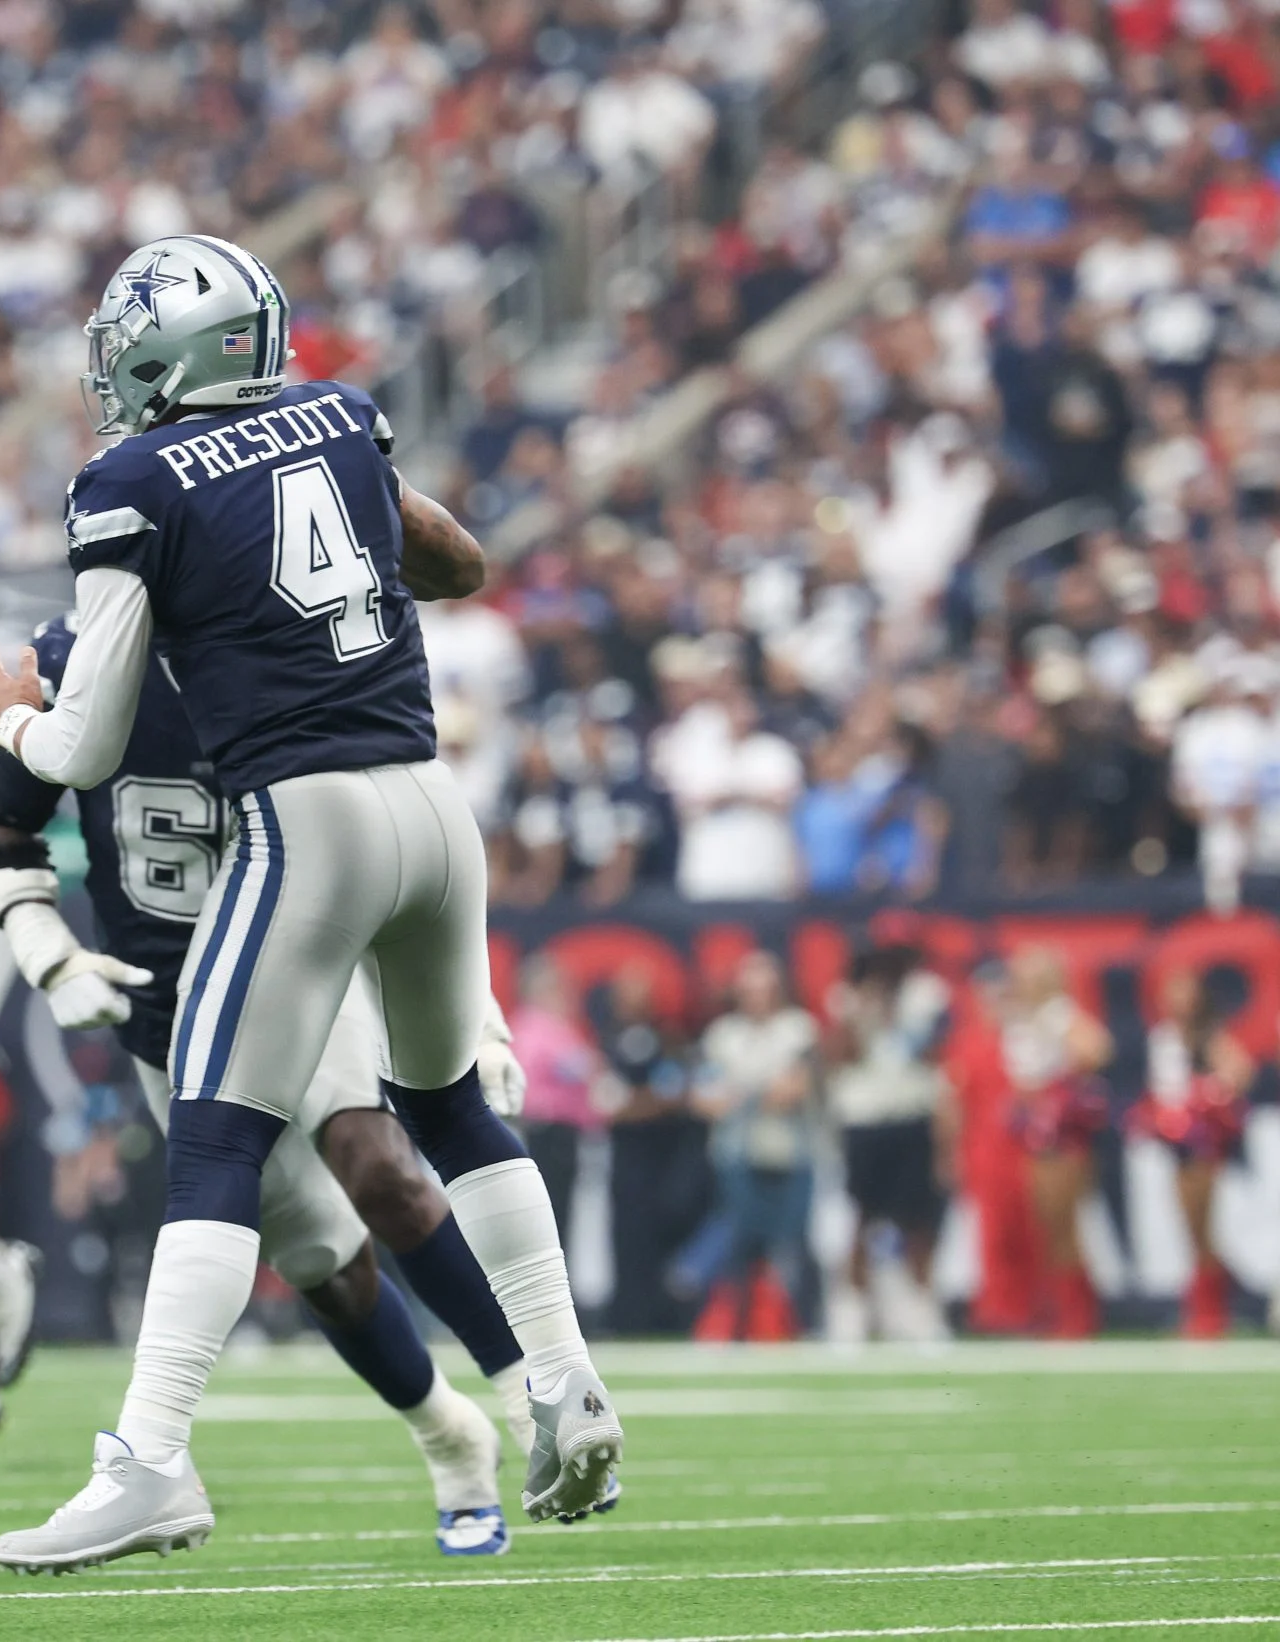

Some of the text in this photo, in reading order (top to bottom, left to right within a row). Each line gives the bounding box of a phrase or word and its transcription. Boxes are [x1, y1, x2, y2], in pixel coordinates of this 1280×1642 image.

[156, 393, 362, 490] PRESCOTT
[270, 455, 396, 662] 4
[112, 775, 231, 923] 6
